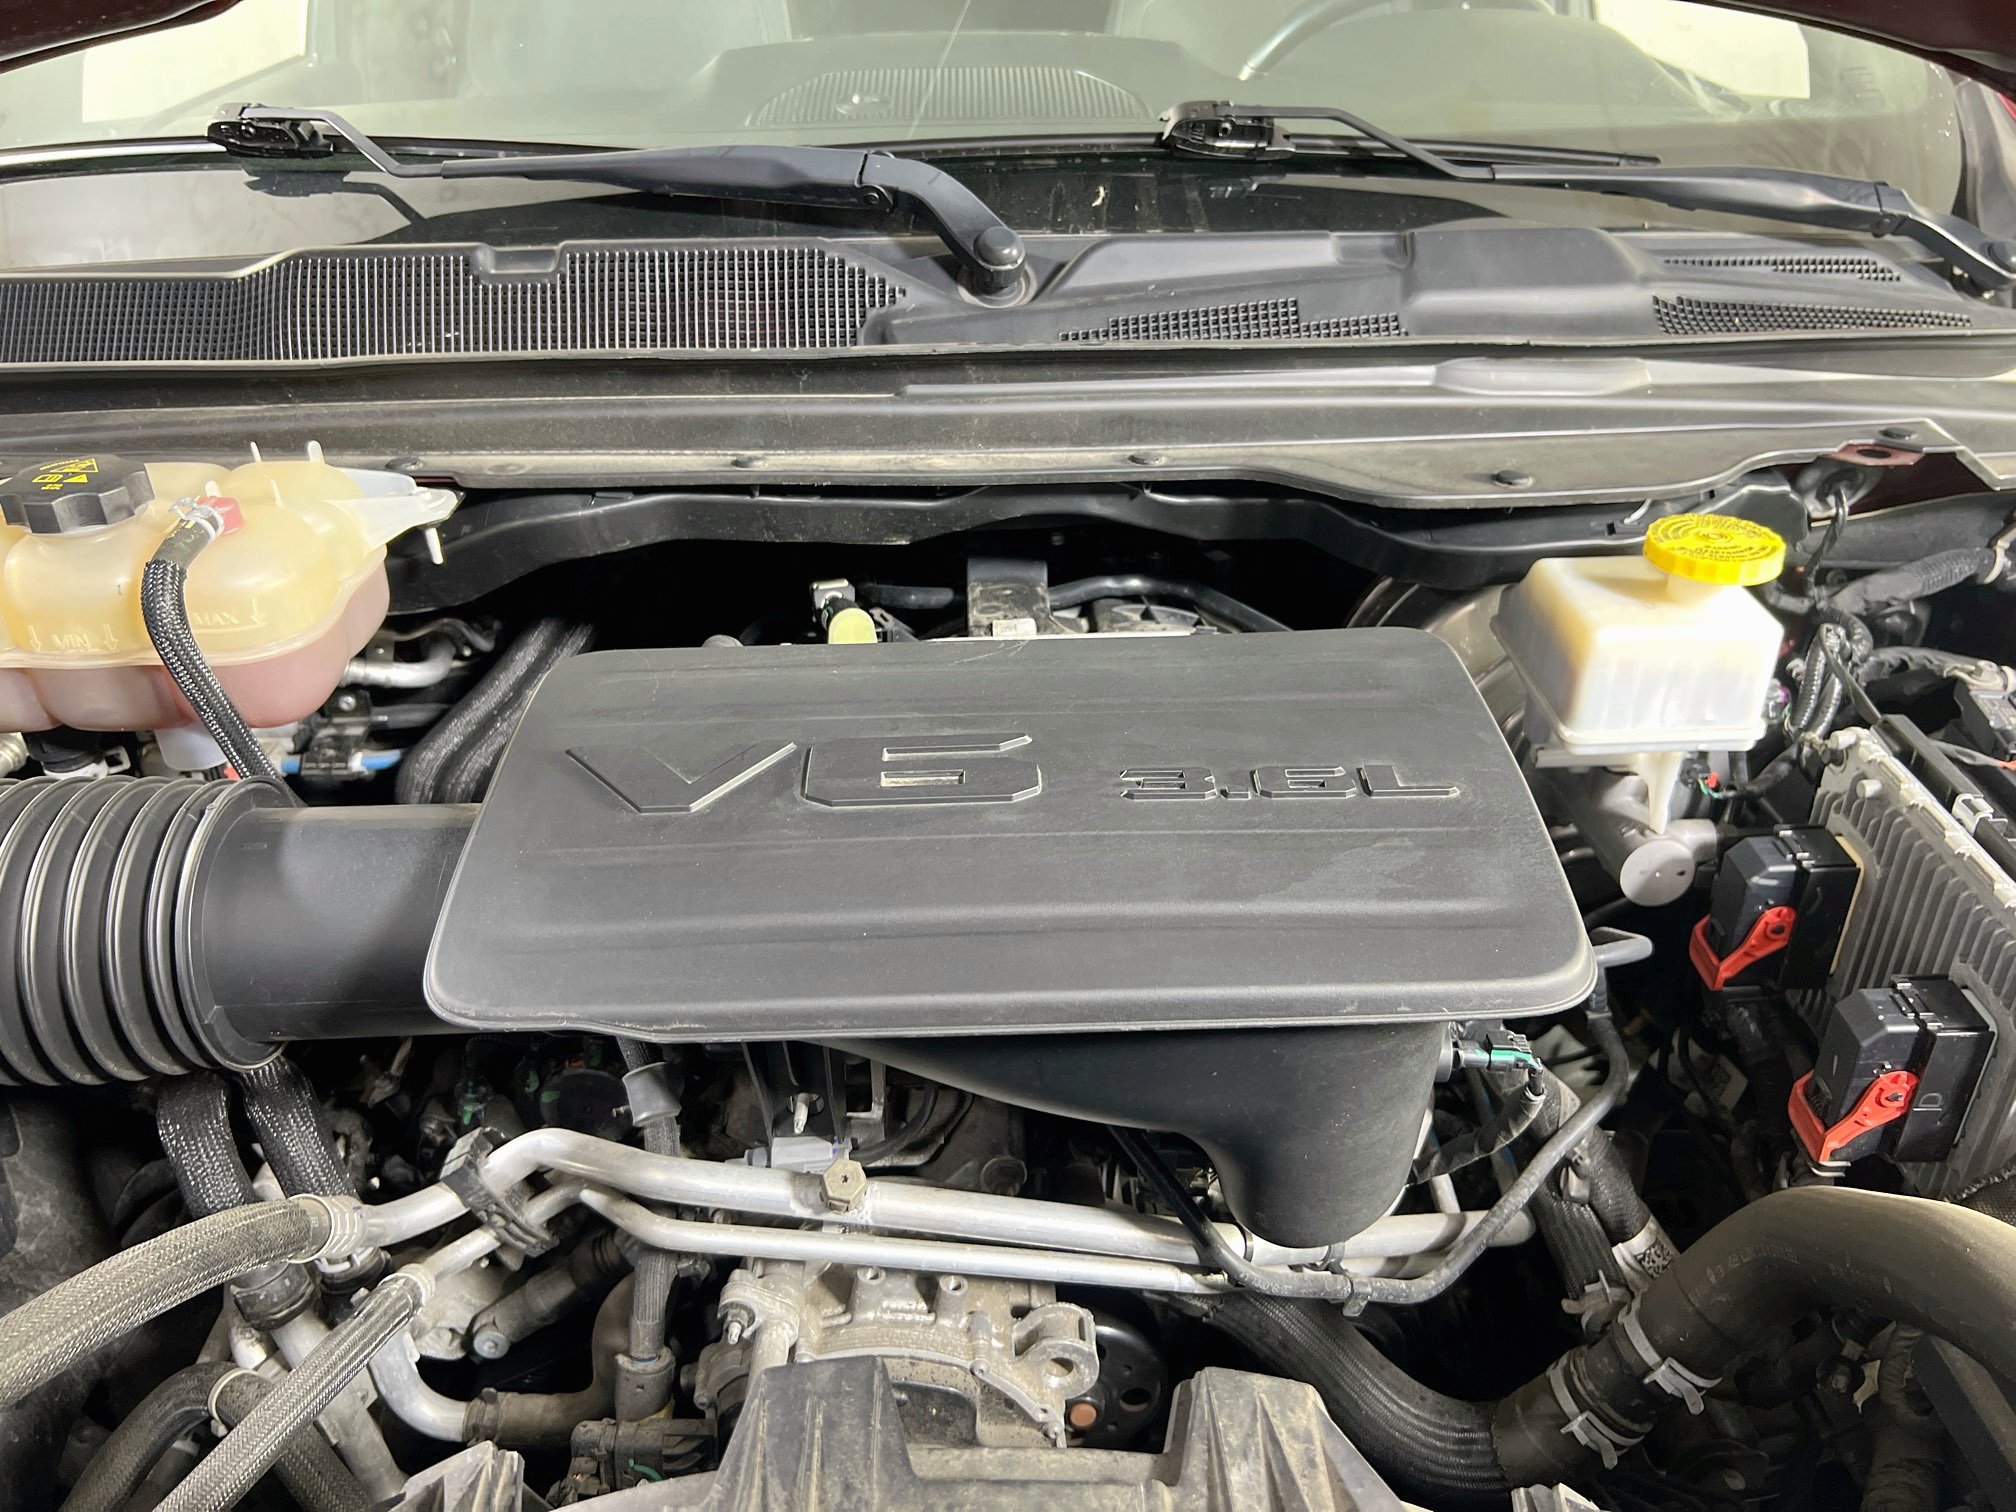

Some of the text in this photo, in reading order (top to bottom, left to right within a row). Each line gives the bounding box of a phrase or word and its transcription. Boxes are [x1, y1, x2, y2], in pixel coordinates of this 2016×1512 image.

[192, 610, 240, 626] MAX
[51, 632, 90, 649] MIN
[565, 732, 1461, 814] V6 3.6L
